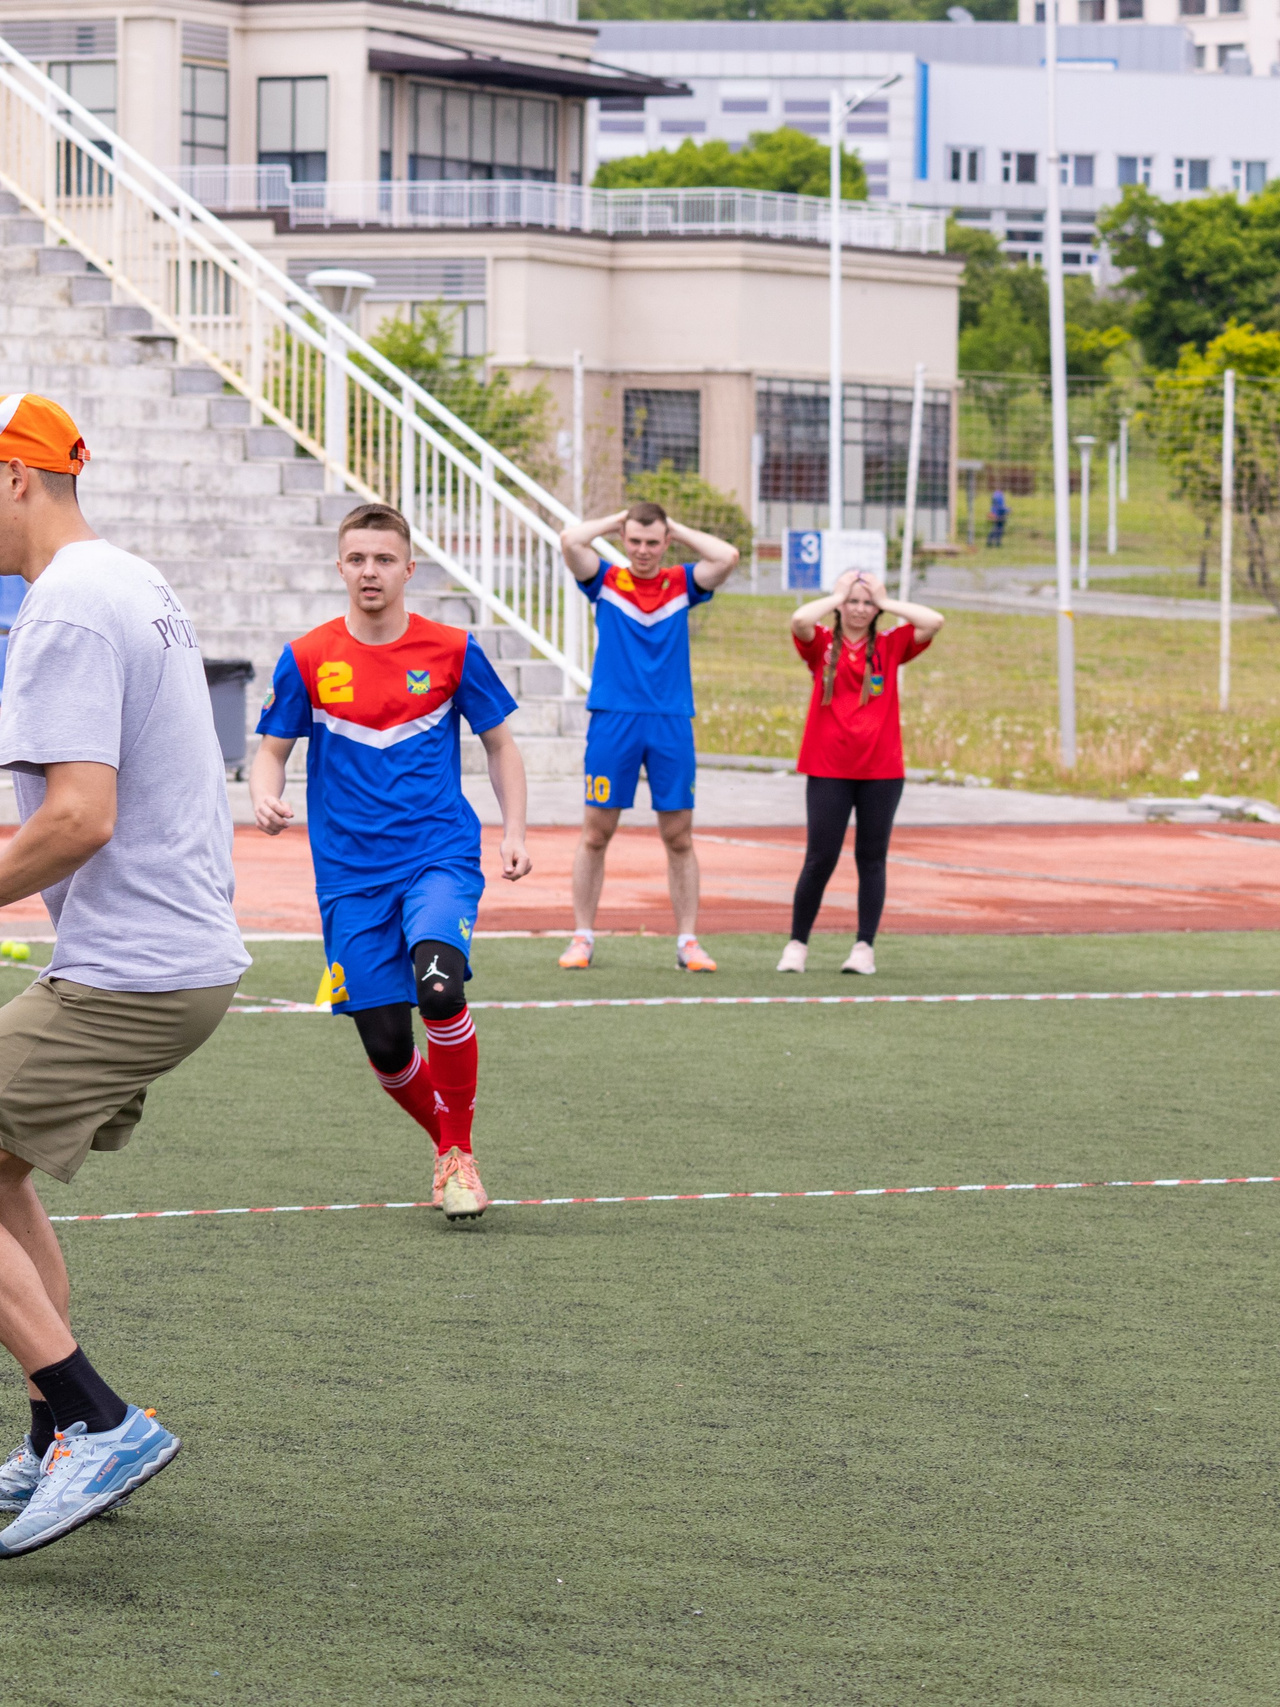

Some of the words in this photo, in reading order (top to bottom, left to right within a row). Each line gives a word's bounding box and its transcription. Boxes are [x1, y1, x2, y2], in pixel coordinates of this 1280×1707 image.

[801, 533, 820, 564] 3
[317, 661, 354, 704] 2
[586, 774, 611, 803] 10
